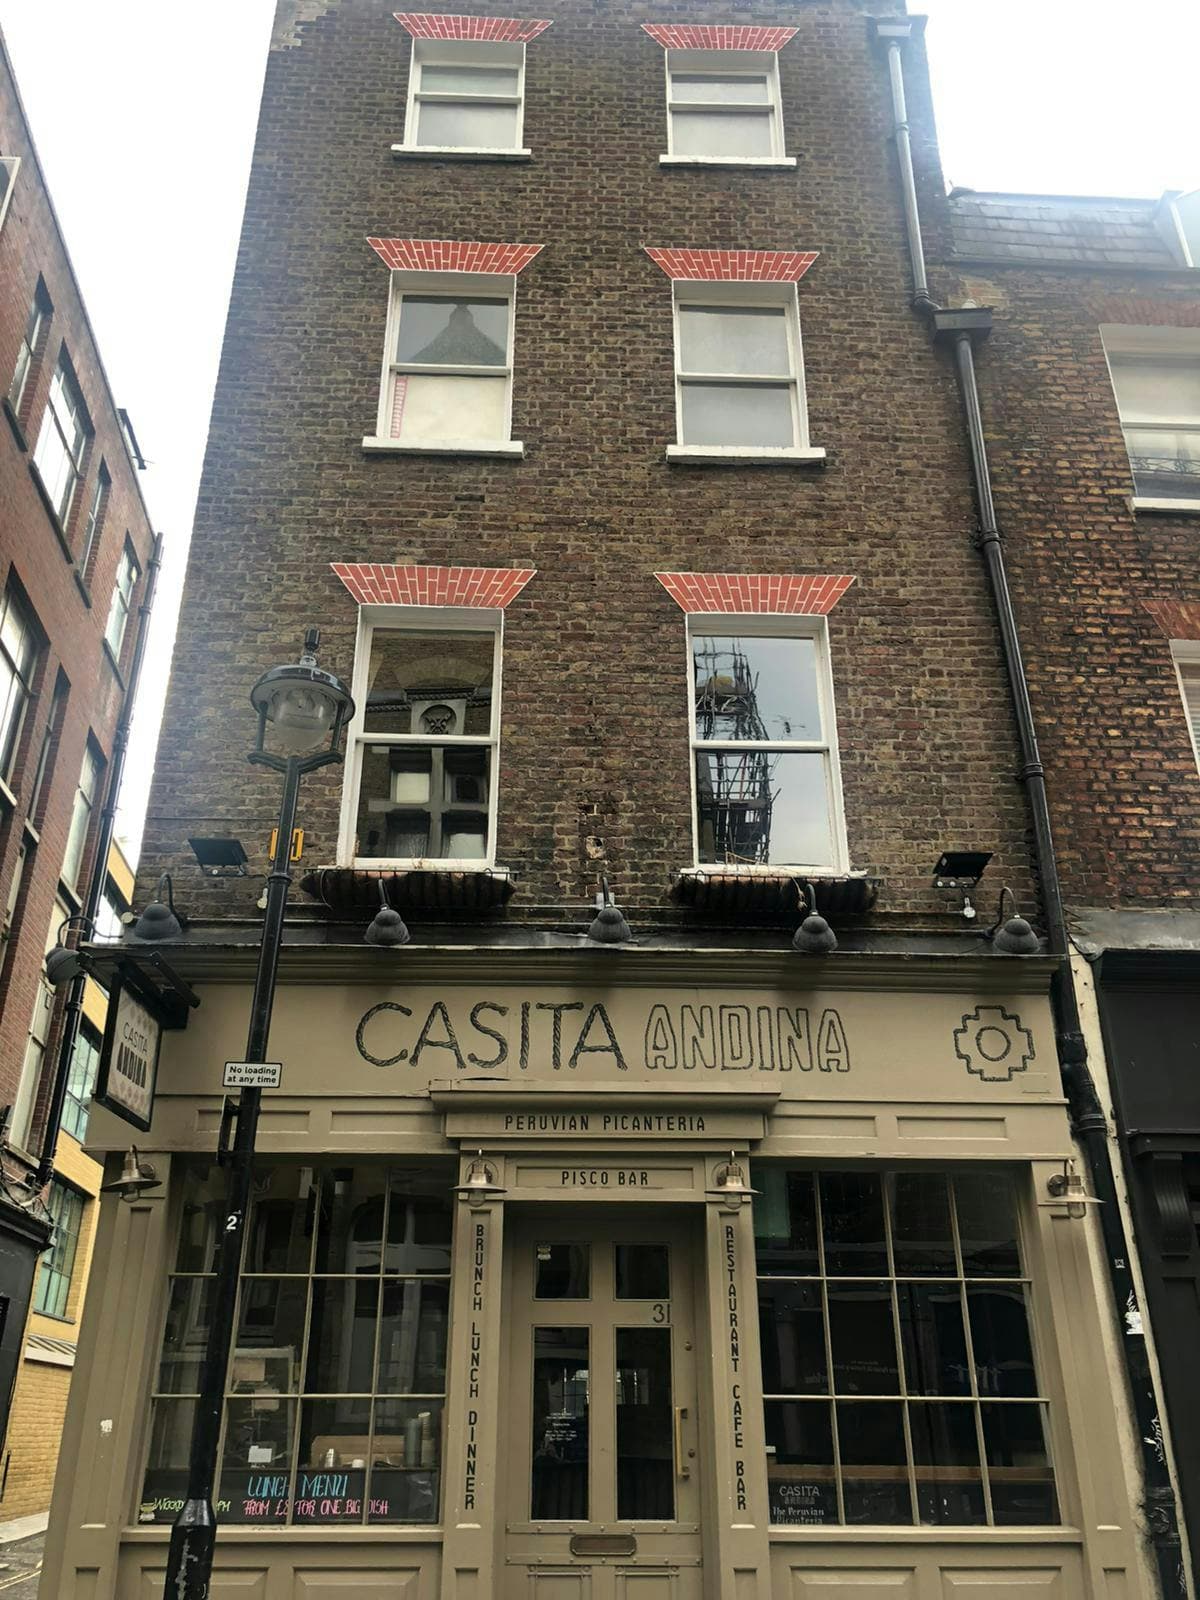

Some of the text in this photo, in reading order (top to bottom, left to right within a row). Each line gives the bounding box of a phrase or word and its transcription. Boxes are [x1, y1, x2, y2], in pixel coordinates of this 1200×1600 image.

[122, 1022, 148, 1053] CASITA
[356, 1001, 850, 1072] CASITA ANDINA
[244, 1066, 277, 1076] loading
[239, 1076, 255, 1084] any
[257, 1075, 277, 1083] time
[504, 1115, 706, 1132] PERUVIAN PICANTERIA
[561, 1171, 649, 1186] PISCO BAR
[226, 1215, 237, 1230] 2
[653, 1303, 671, 1324] 31
[464, 1223, 485, 1510] BRUNCH LUNCH DINNER
[725, 1225, 747, 1510] RESTAURANT CAFE BAR
[247, 1473, 349, 1498] LUNCH MENU
[779, 1485, 821, 1497] CASITA
[320, 1499, 342, 1515] ONE
[787, 1506, 825, 1516] Peruvian
